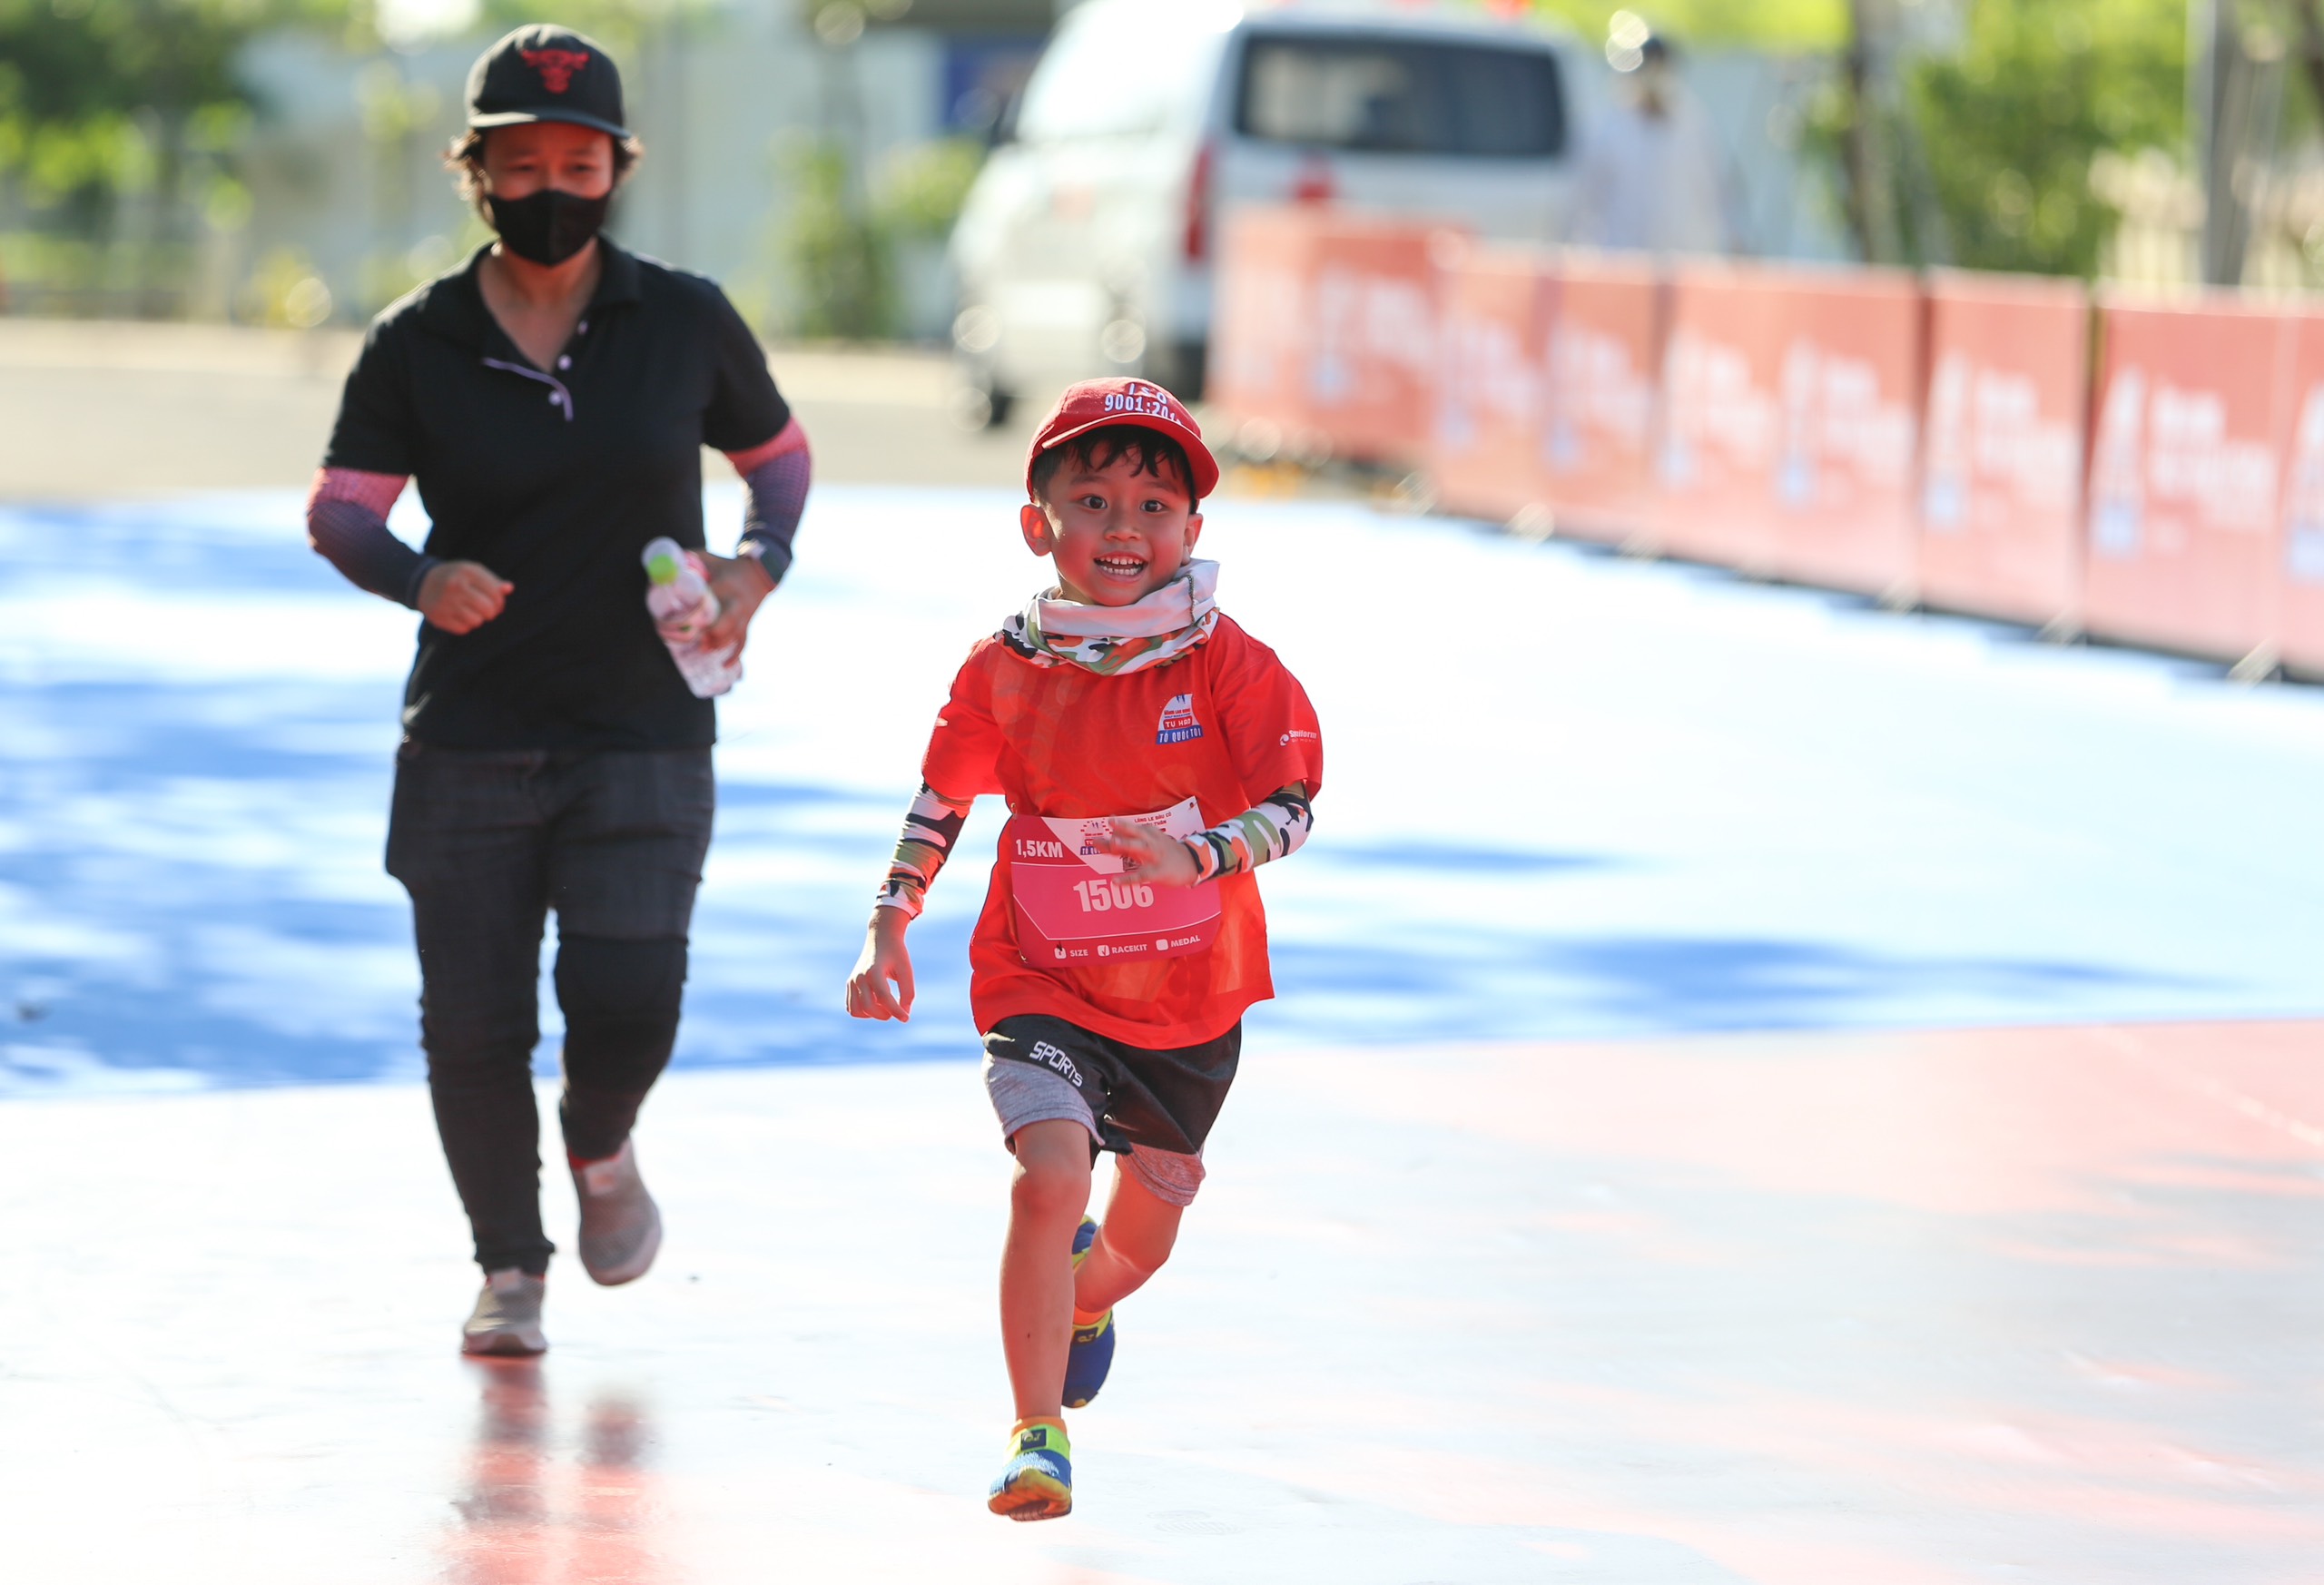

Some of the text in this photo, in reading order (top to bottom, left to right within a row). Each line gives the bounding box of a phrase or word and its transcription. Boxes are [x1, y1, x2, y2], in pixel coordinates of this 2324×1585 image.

[1128, 383, 1167, 405] ISO
[1016, 839, 1063, 859] 1,5KM
[1073, 879, 1155, 912] 1506
[1069, 935, 1201, 958] SIZE RACEKIT MEDAL
[1029, 1040, 1084, 1088] SPORTS
